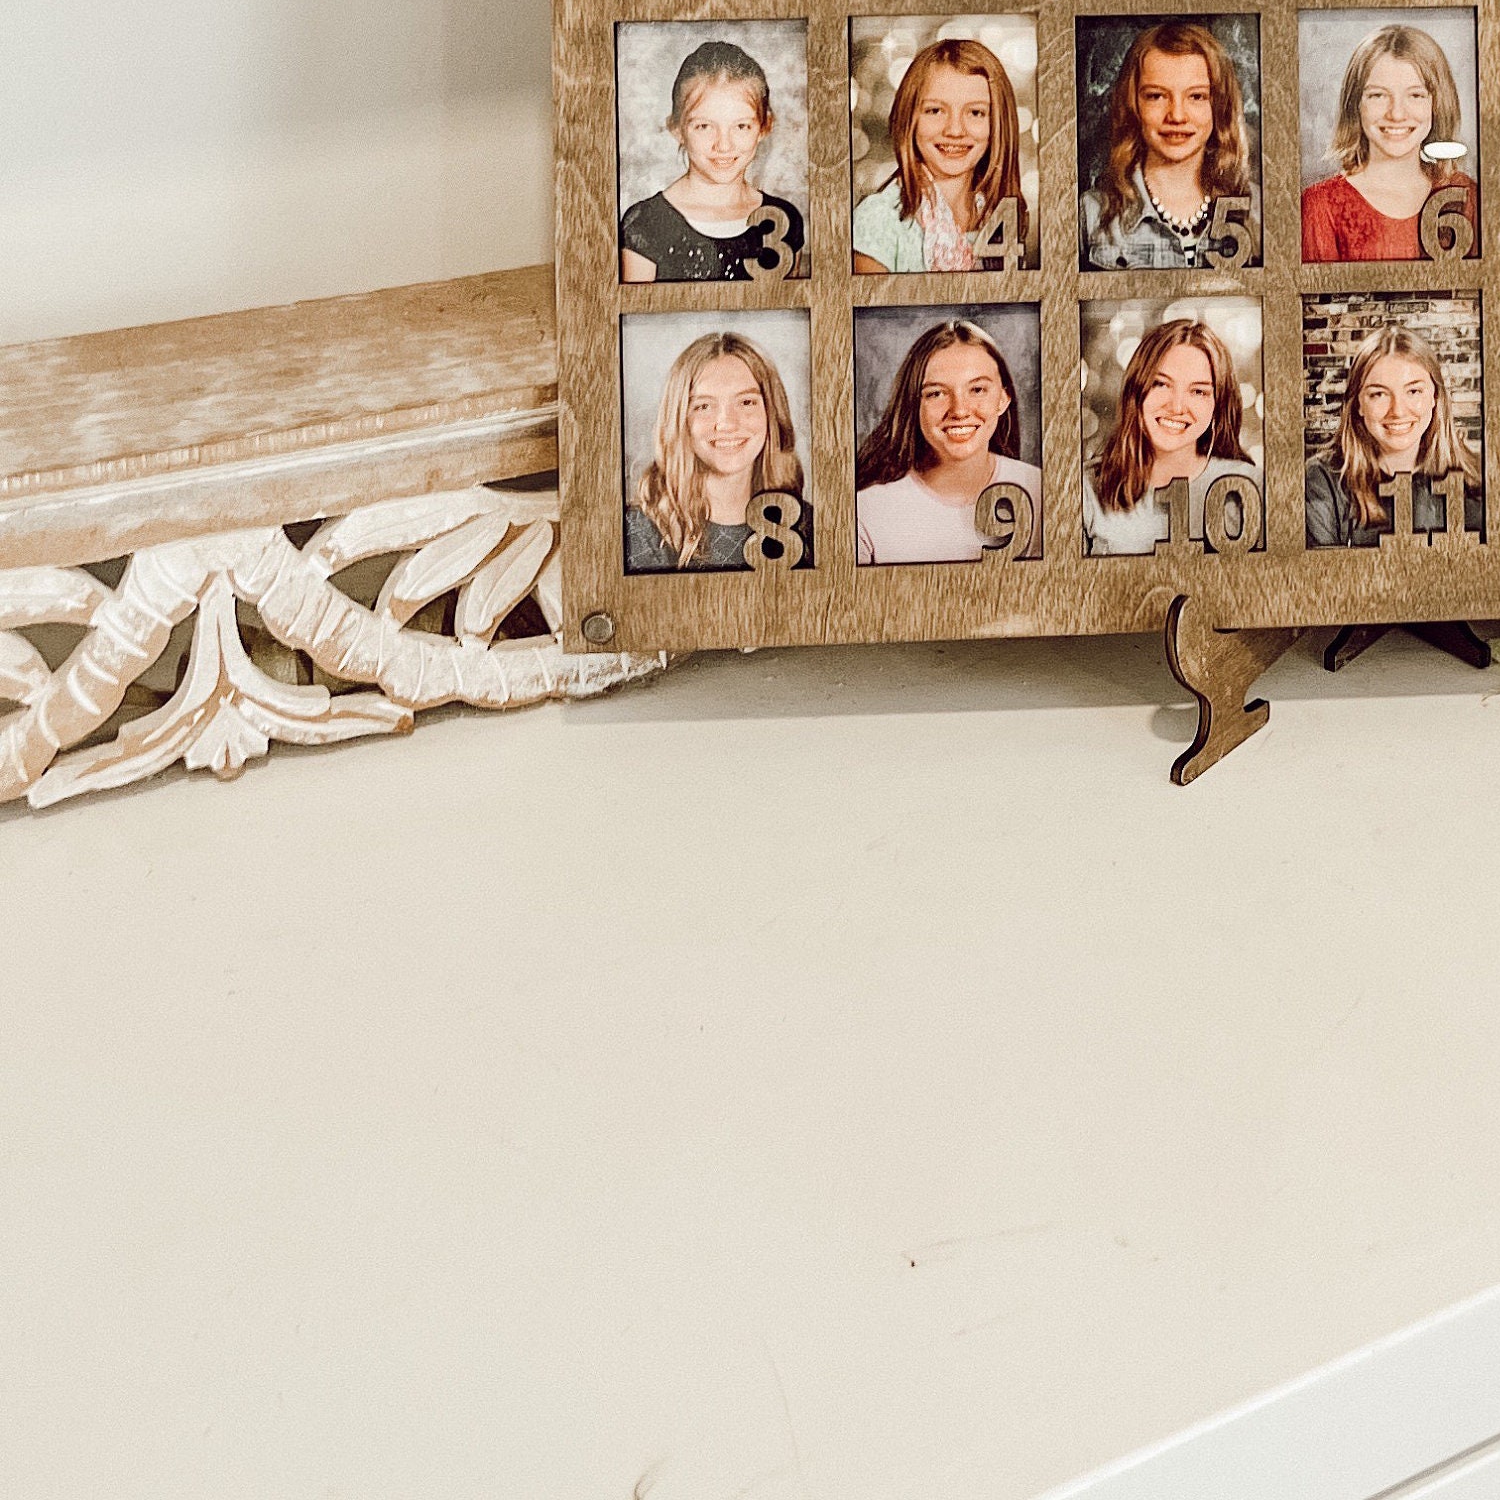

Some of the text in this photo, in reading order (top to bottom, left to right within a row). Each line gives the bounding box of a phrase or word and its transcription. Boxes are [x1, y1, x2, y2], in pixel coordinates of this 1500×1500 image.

[743, 205, 798, 282] 3
[974, 197, 1025, 271] 4
[1204, 195, 1253, 269] 5
[1419, 185, 1477, 260] 6
[743, 491, 804, 570] 8
[974, 482, 1035, 561] 9
[1152, 473, 1264, 553] 10
[1378, 470, 1470, 545] 11
